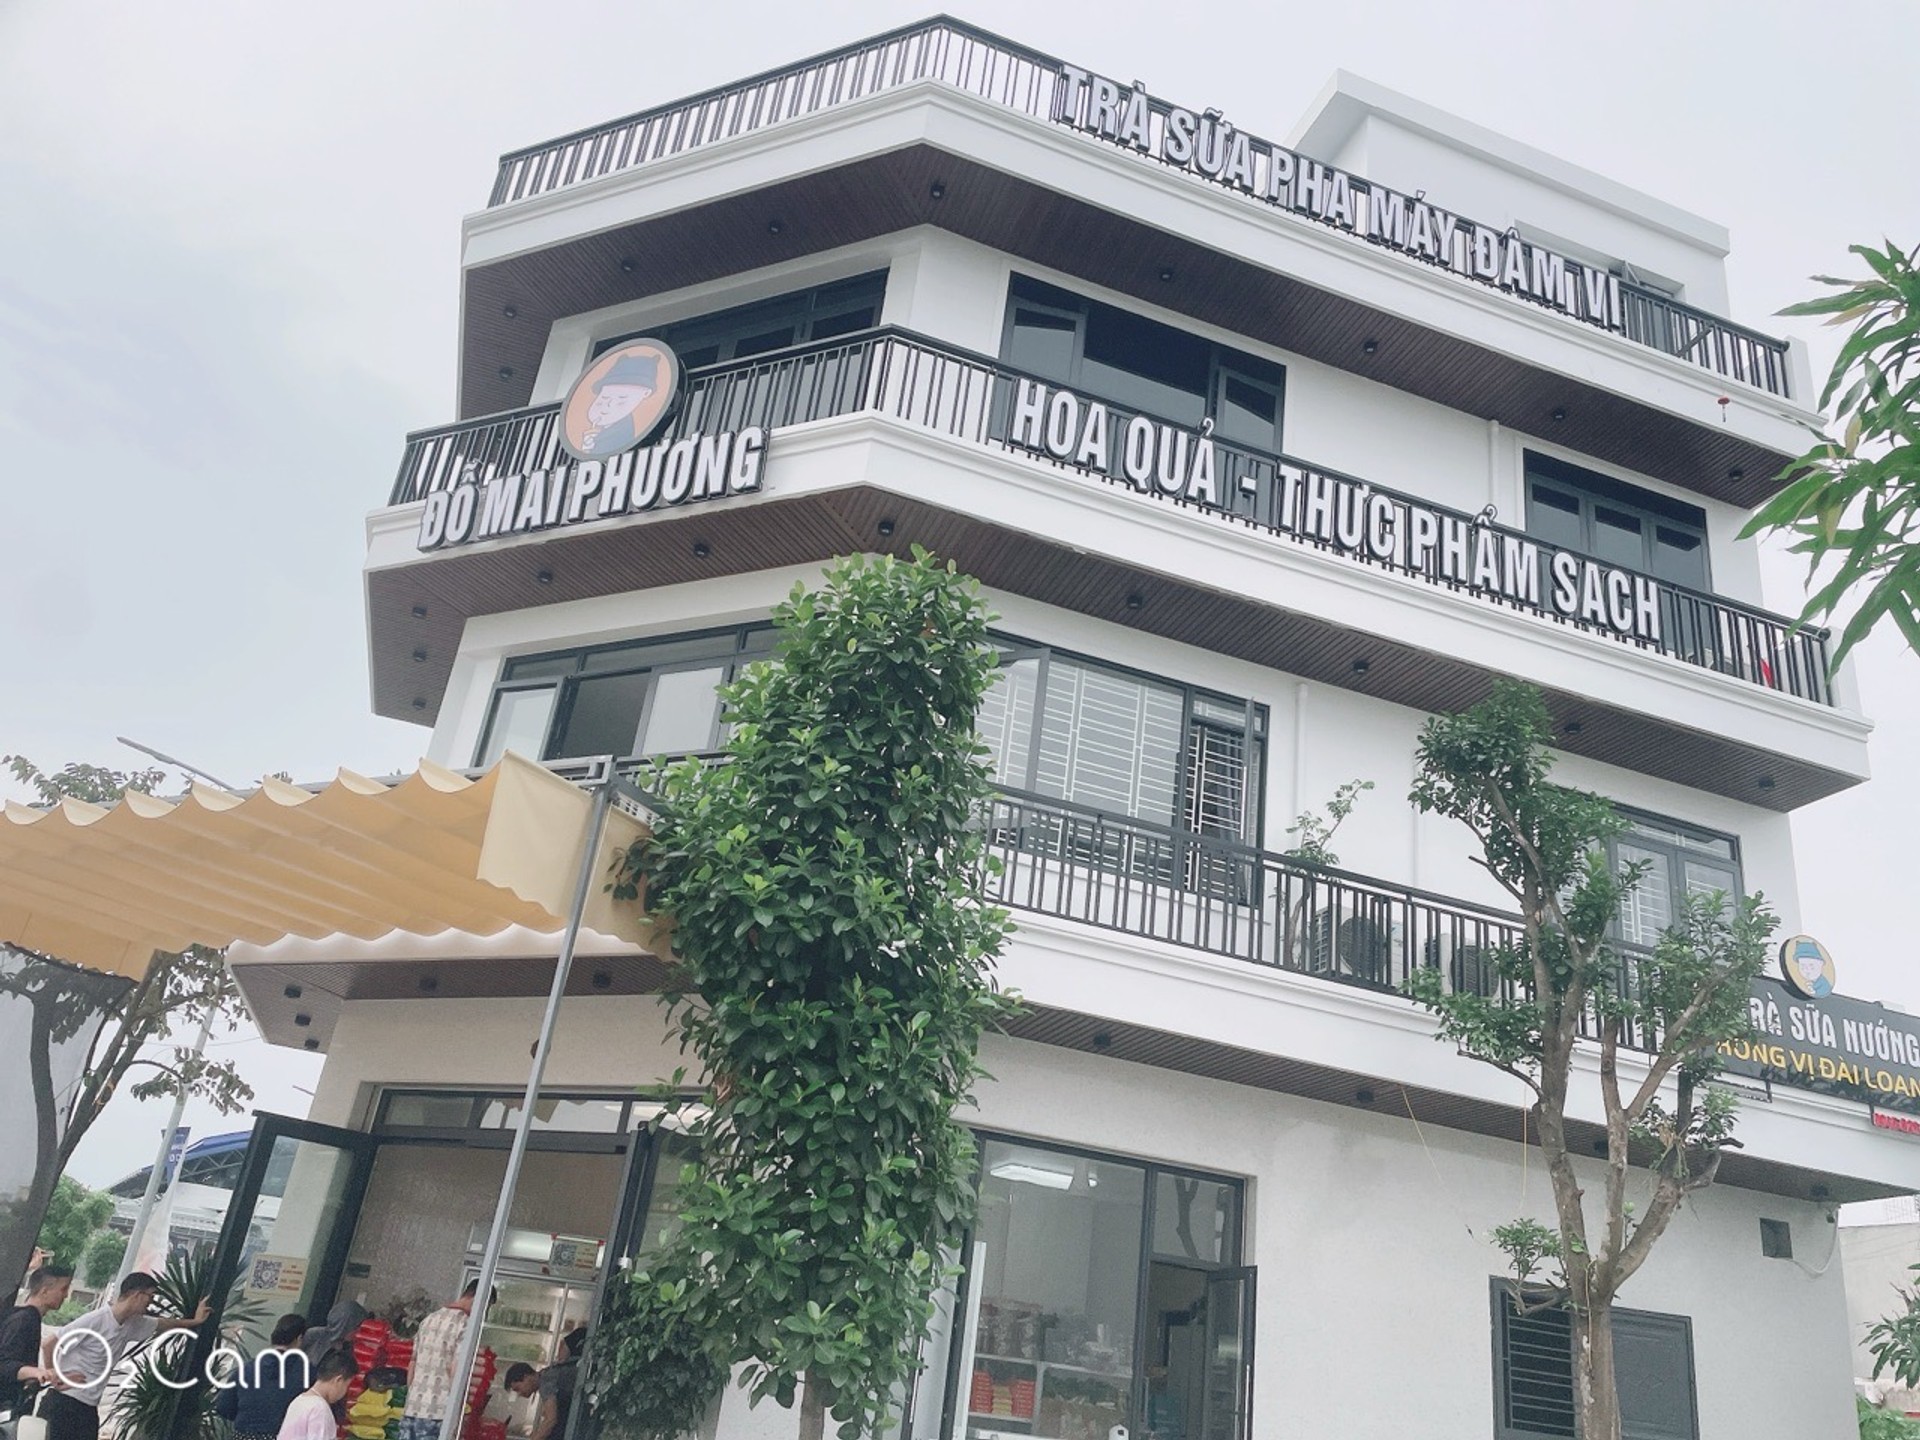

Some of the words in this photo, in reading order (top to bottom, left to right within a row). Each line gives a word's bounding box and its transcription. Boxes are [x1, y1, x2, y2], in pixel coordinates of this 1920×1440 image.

[1059, 63, 1150, 153] TRÀ
[1164, 106, 1254, 194] SỮA
[1267, 147, 1354, 230] PHA
[1366, 189, 1457, 268] MÁY
[417, 457, 482, 552] ĐỖ
[477, 464, 572, 538] MAI
[565, 426, 766, 522] PHƯƠNG
[1009, 378, 1108, 473] HOA
[1123, 416, 1218, 505] QUẢ
[1237, 475, 1258, 495] -
[1408, 502, 1541, 606] PHẨM
[1747, 991, 1784, 1037] RÀ
[1788, 1003, 1837, 1050] SỮA
[1842, 1018, 1920, 1069] NƯỚNG
[1789, 1049, 1815, 1081] VỊ
[1819, 1055, 1860, 1086] ĐÀI
